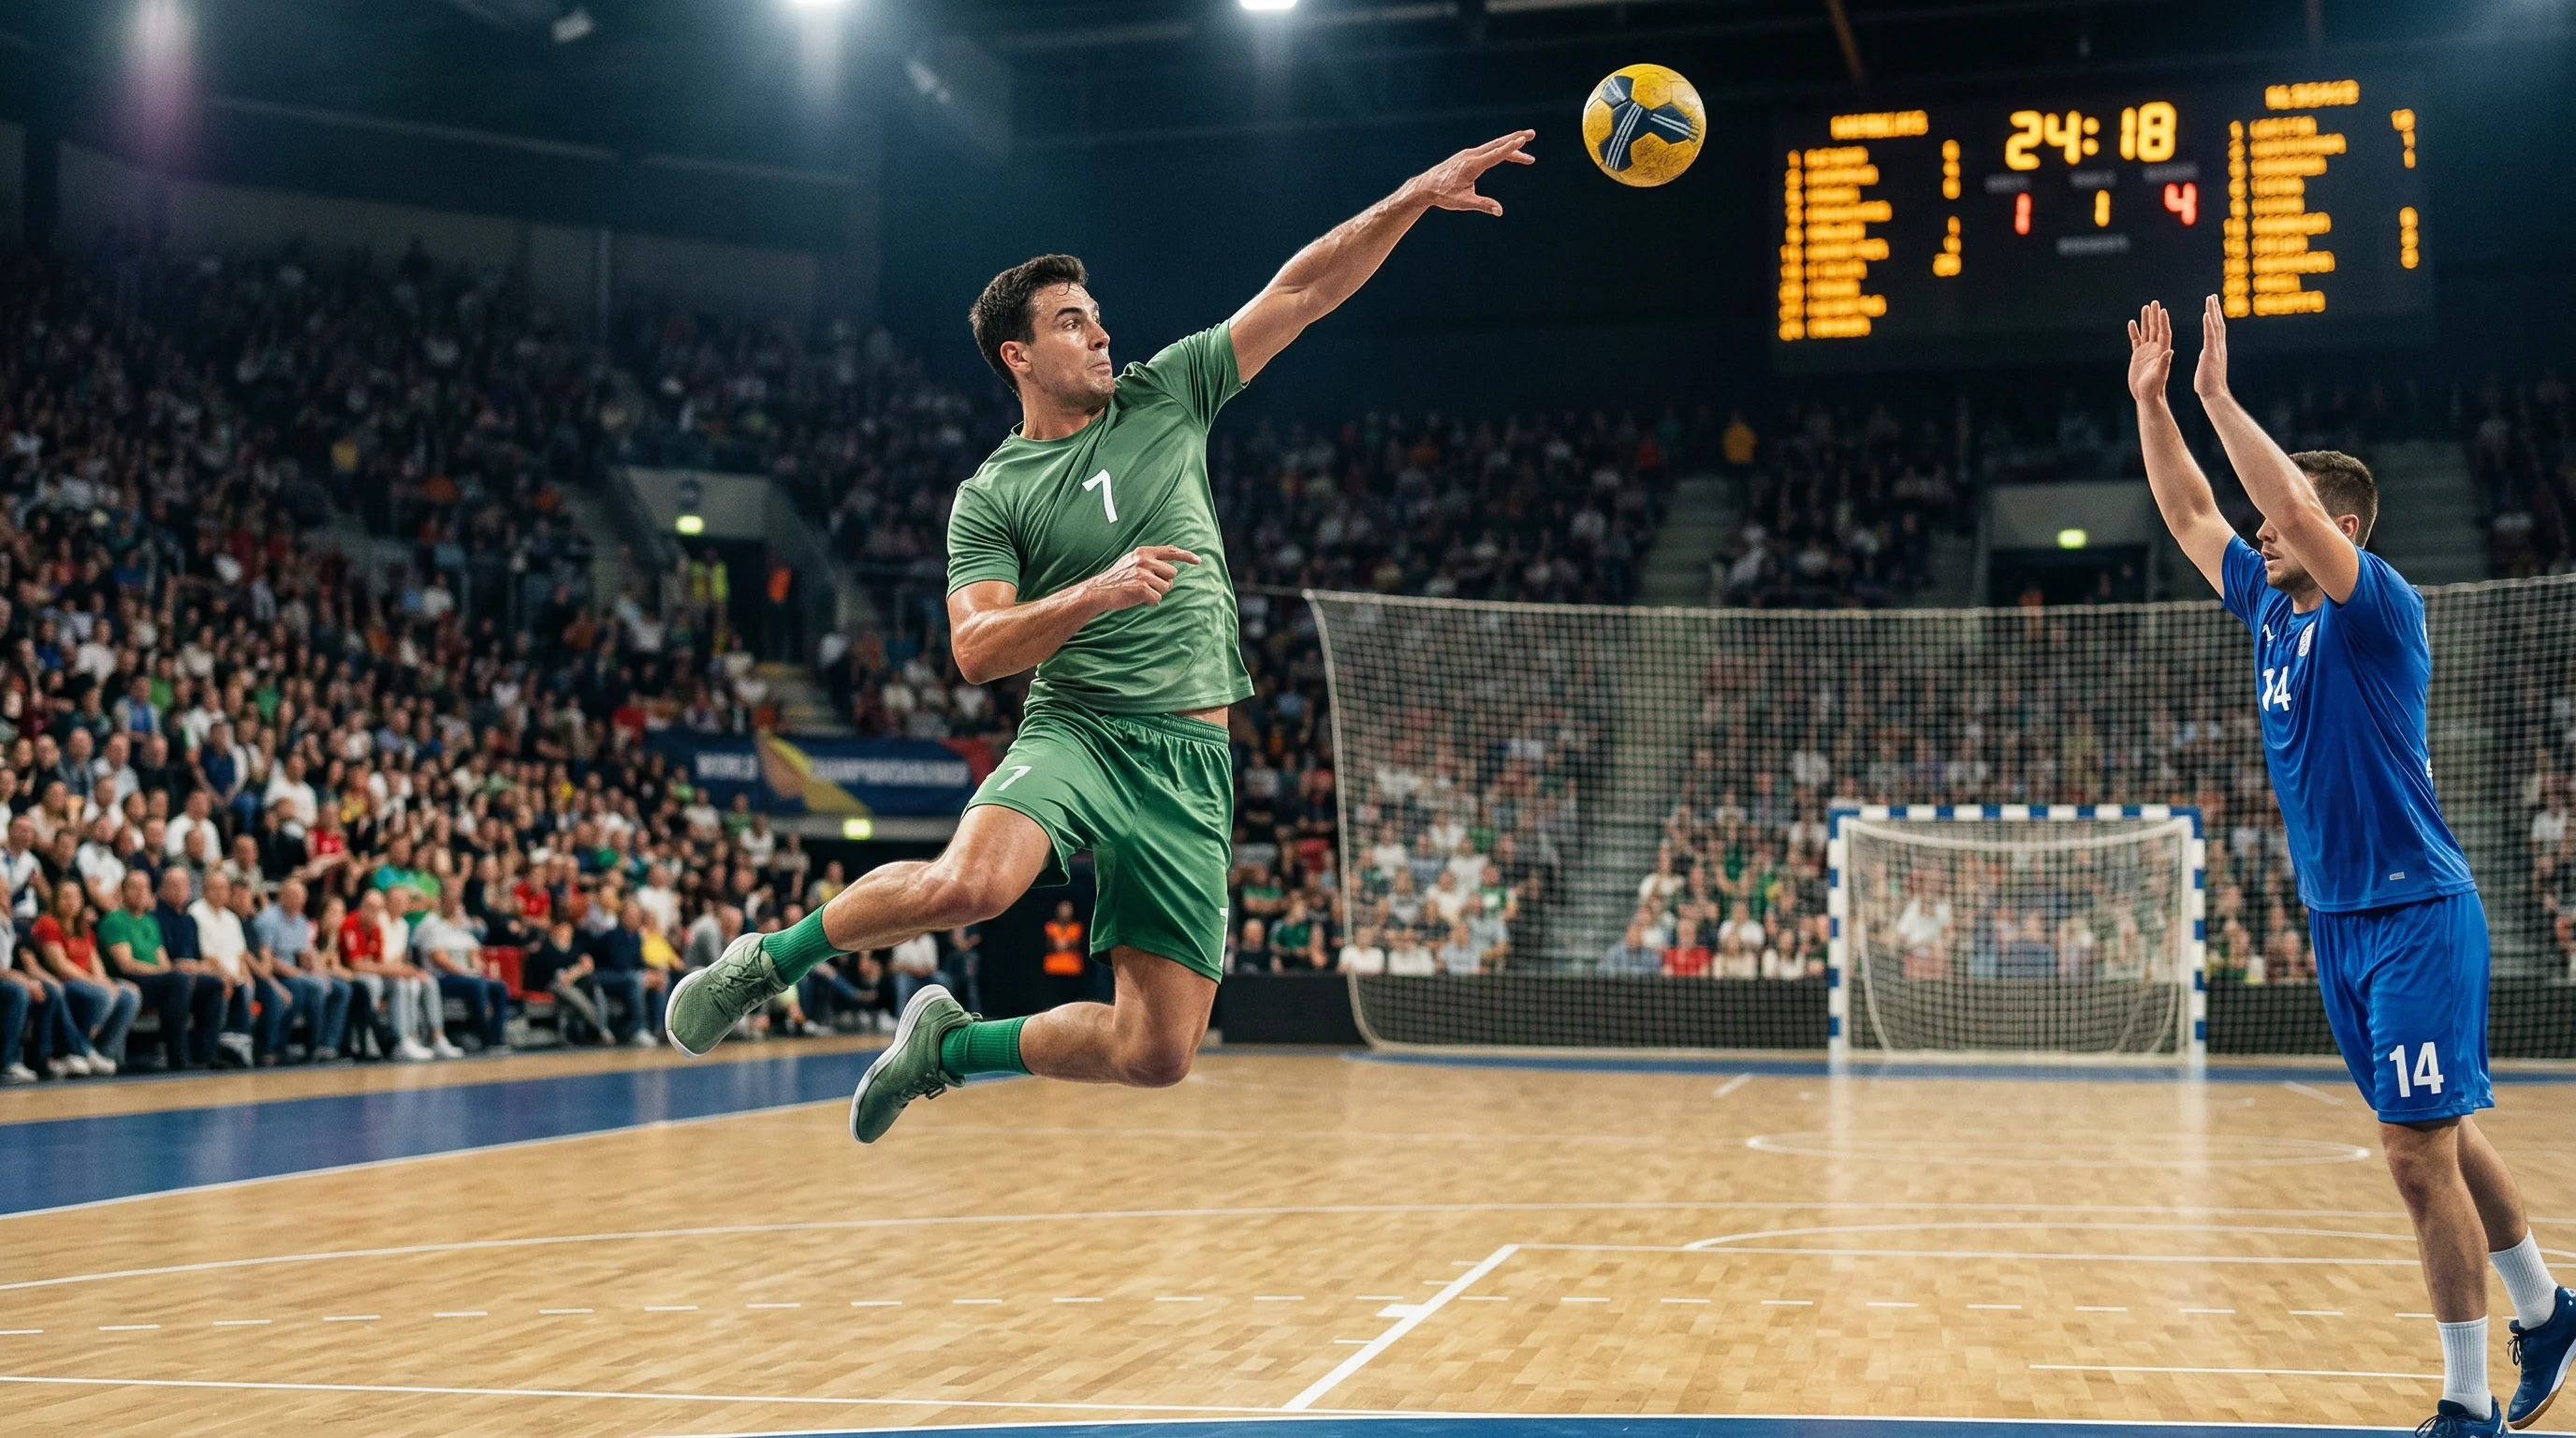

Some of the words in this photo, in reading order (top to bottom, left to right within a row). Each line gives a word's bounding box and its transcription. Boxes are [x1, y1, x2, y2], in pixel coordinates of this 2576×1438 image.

[2014, 192, 2032, 236] 1
[2094, 189, 2111, 227] 1
[2163, 182, 2198, 227] 4
[1082, 469, 1118, 524] 7
[2261, 666, 2292, 712] 14
[996, 765, 1032, 792] 7
[2389, 1041, 2445, 1098] 14
